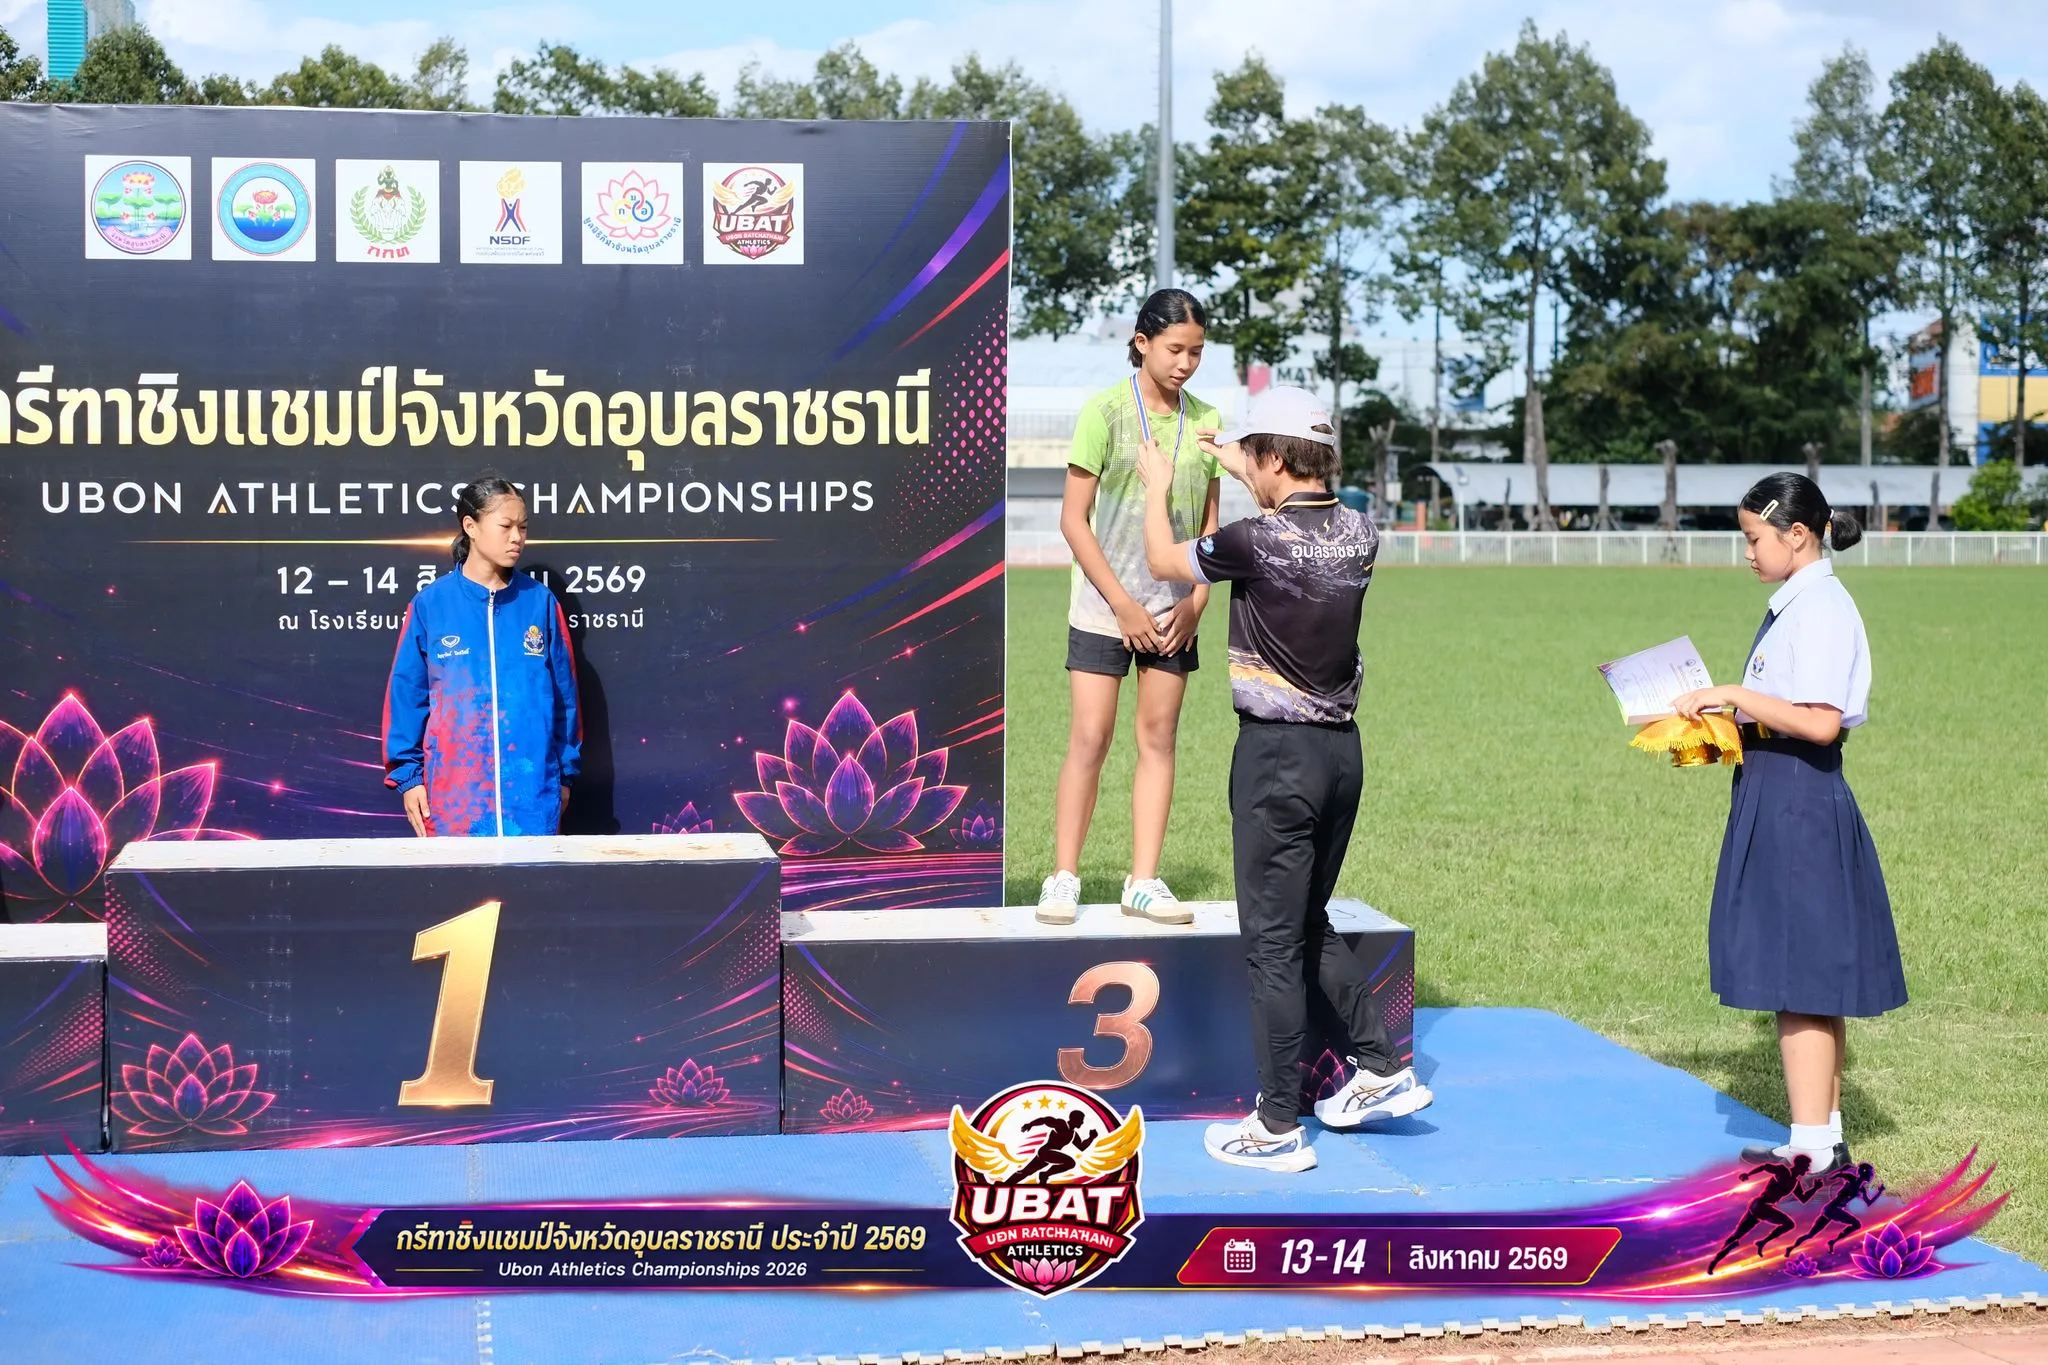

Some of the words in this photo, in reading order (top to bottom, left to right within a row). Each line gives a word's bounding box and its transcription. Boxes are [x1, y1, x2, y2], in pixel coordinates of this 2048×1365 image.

[719, 215, 789, 233] UBAT
[489, 235, 531, 245] NSDF
[42, 482, 182, 514] UBON
[516, 480, 874, 515] HAMPIONSHIPS
[1291, 538, 1369, 564] อุบลราชธานี
[277, 566, 313, 594] 12
[362, 566, 399, 594] 14
[565, 564, 646, 594] 2569
[278, 614, 299, 630] ณ
[309, 609, 408, 630] โรงเรียน
[397, 901, 502, 1107] 1
[1056, 961, 1160, 1090] 3
